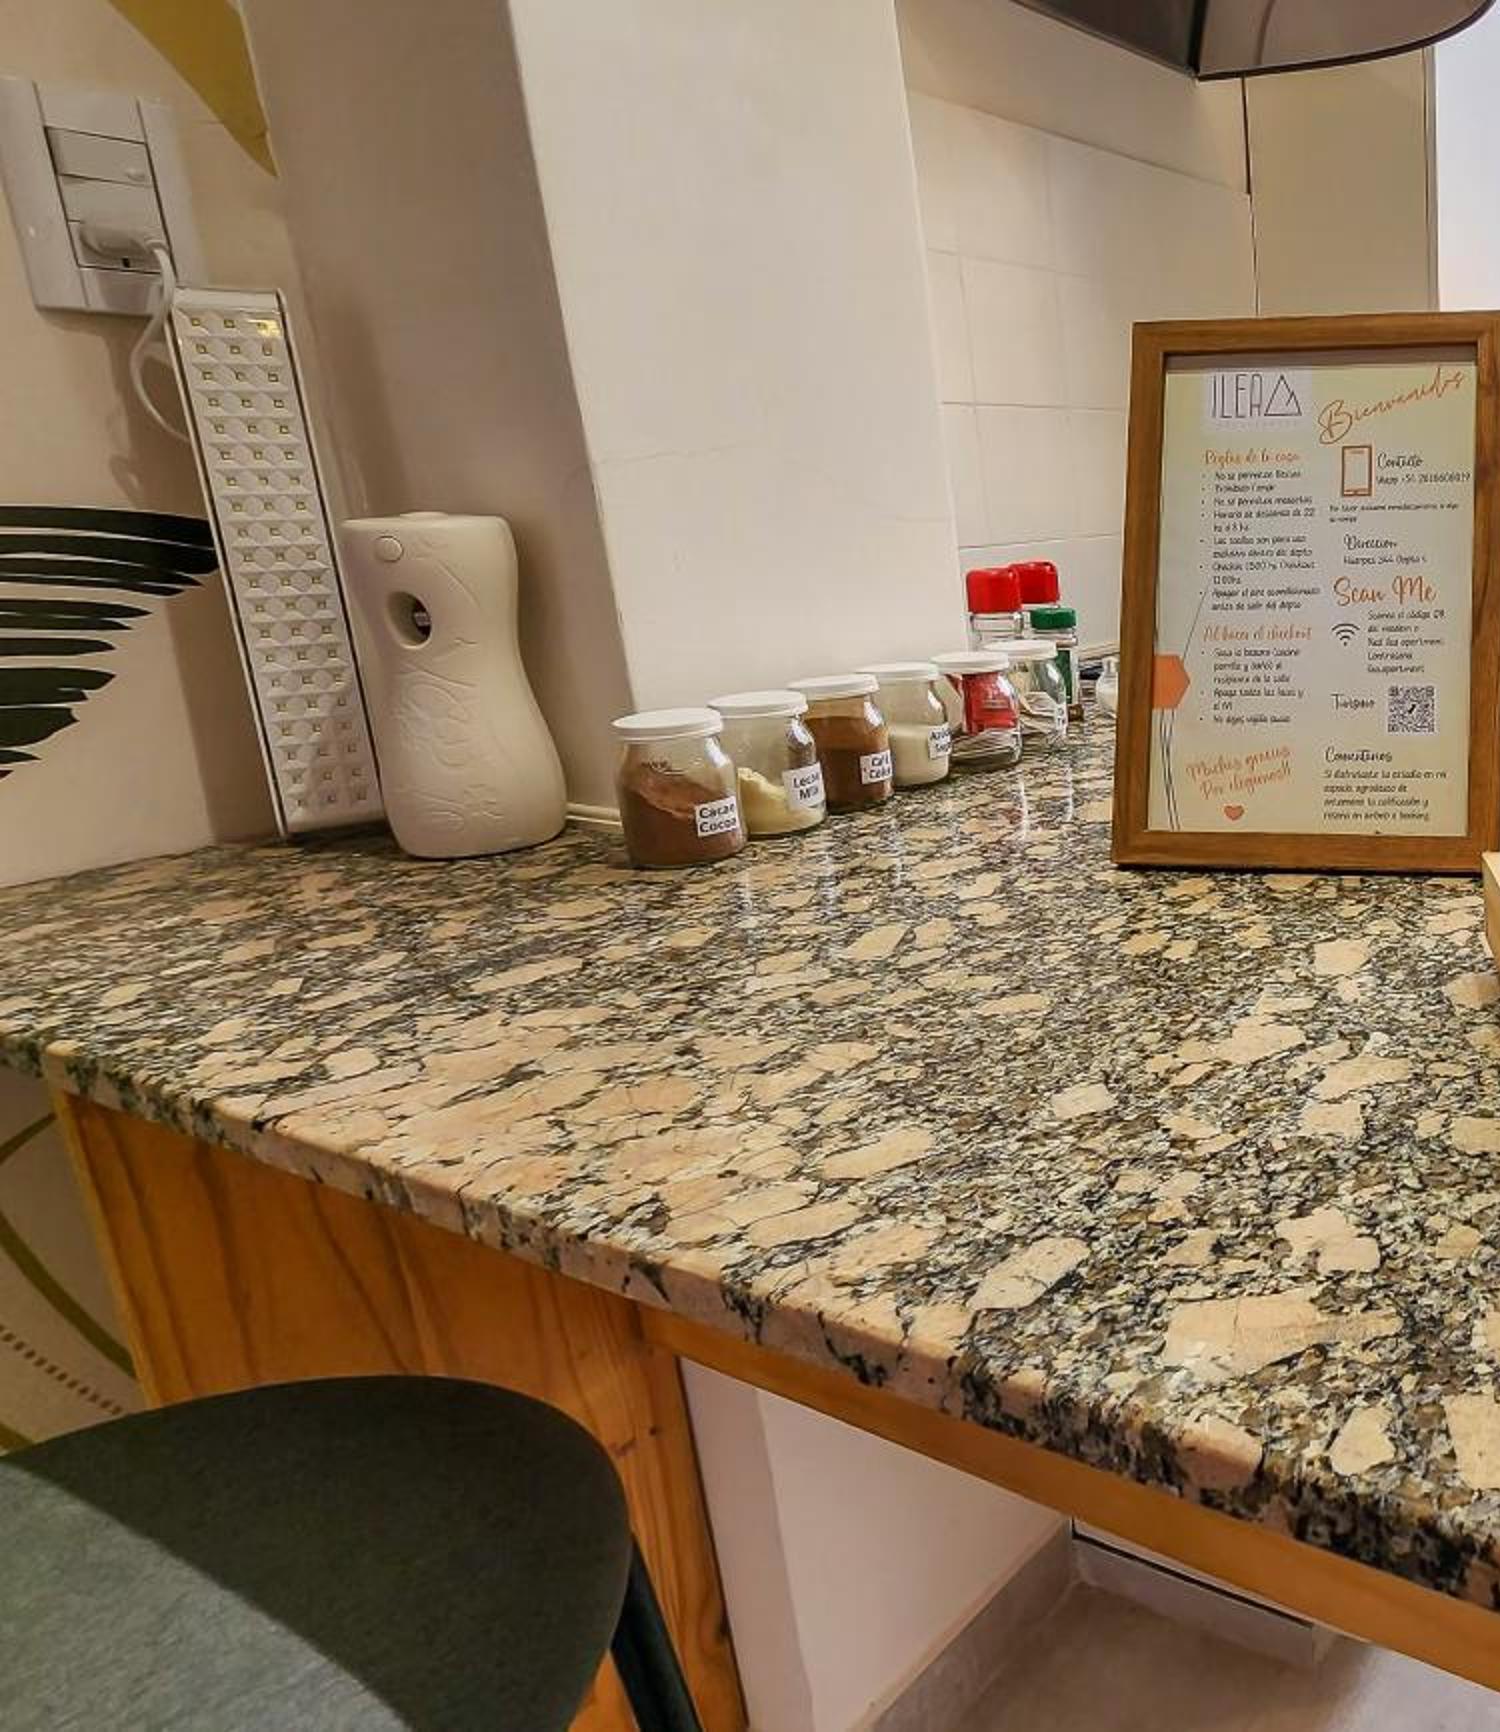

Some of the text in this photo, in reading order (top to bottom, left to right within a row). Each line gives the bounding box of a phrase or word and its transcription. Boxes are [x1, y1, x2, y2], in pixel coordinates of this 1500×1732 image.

[1377, 452, 1423, 470] Contacto
[1333, 574, 1437, 606] Scan Me
[792, 771, 820, 788] Lech
